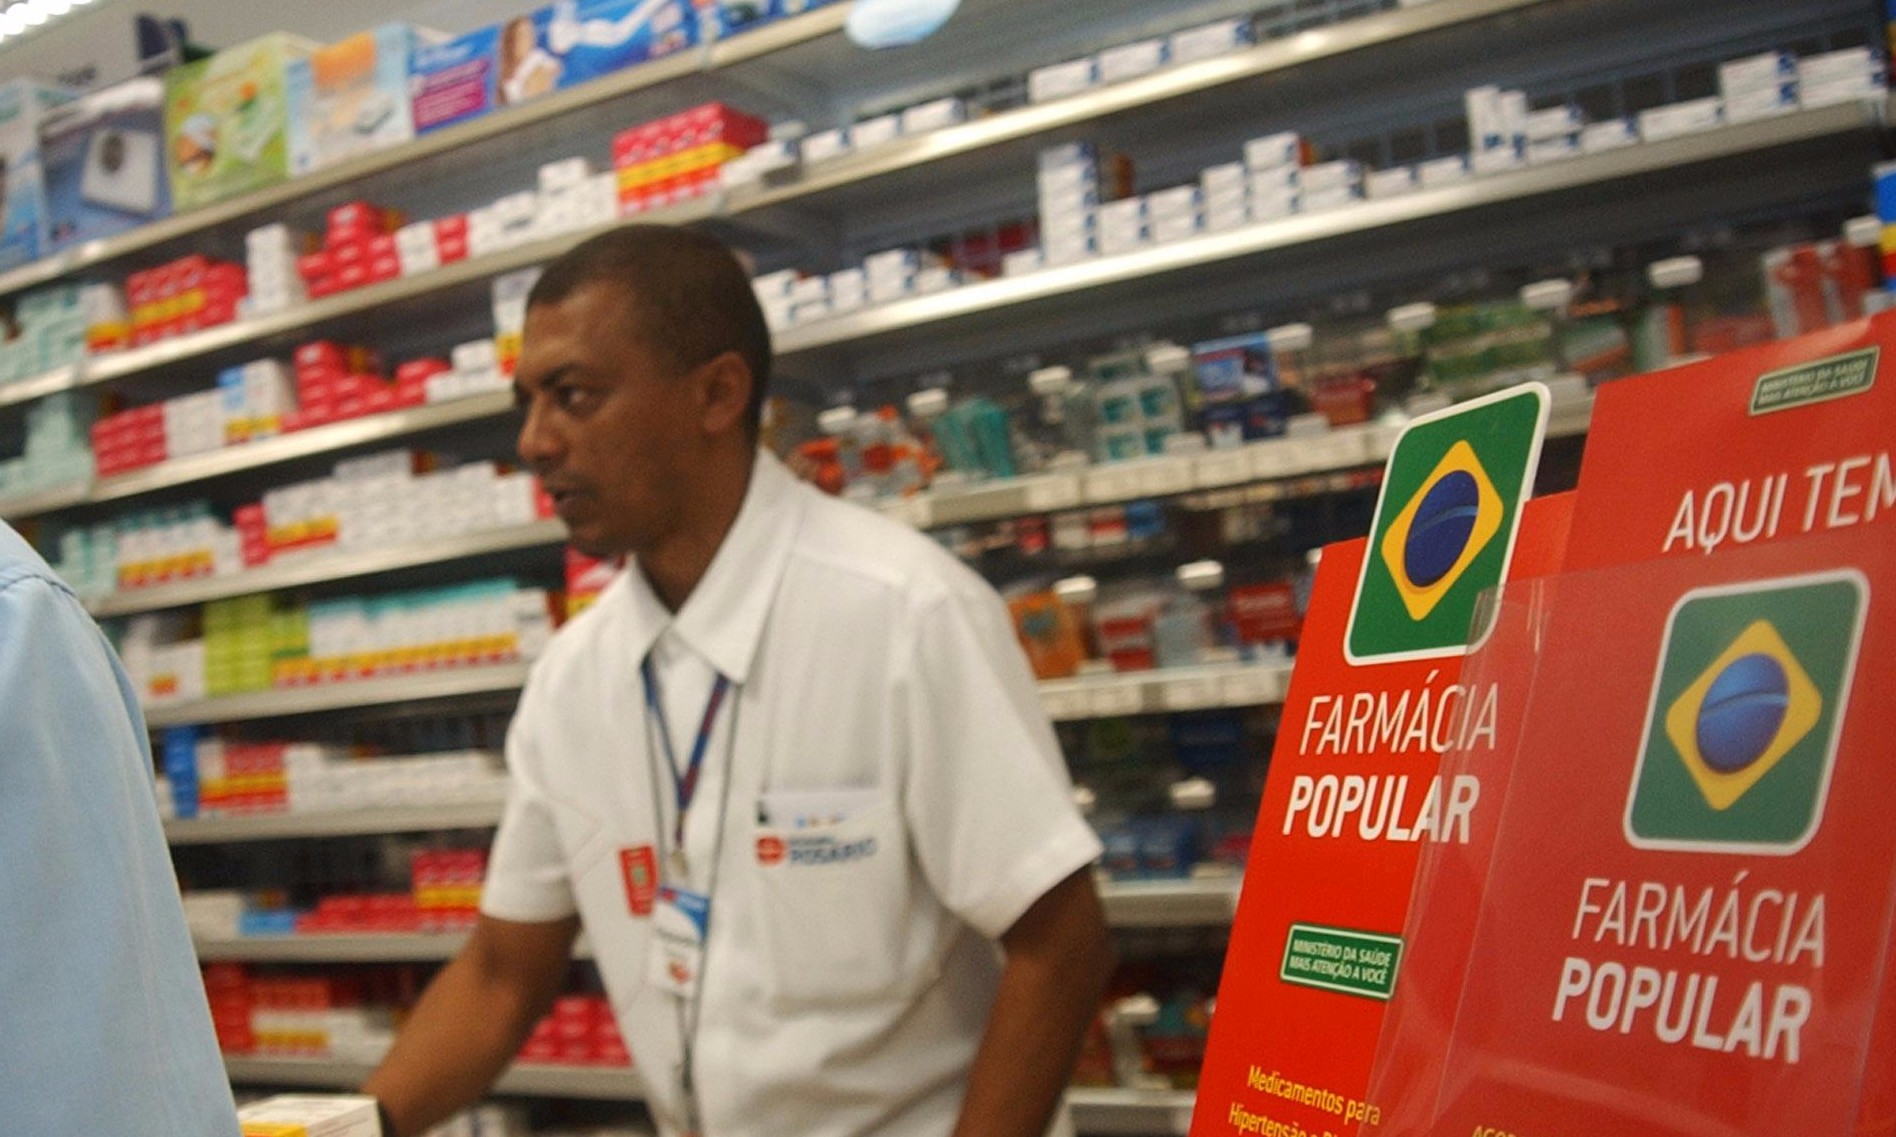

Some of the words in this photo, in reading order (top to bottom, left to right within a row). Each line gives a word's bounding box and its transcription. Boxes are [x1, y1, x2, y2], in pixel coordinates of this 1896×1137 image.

[1662, 474, 1788, 555] AQUI
[1299, 669, 1498, 756] FARMÁCIA
[1282, 774, 1480, 844] POPULAR
[1293, 939, 1342, 959] MINISTÉRIO
[1342, 946, 1357, 960] DA
[1359, 948, 1392, 967] SAÚDE
[1572, 870, 1825, 968] FARMÁCIA
[1289, 955, 1311, 971] MAIS
[1311, 958, 1350, 981] ATENÇÃO
[1351, 966, 1360, 980] A
[1361, 967, 1388, 985] VOCÊ
[1552, 956, 1812, 1064] POPULAR
[1247, 1064, 1344, 1115] Medicamentos
[1344, 1098, 1381, 1126] para
